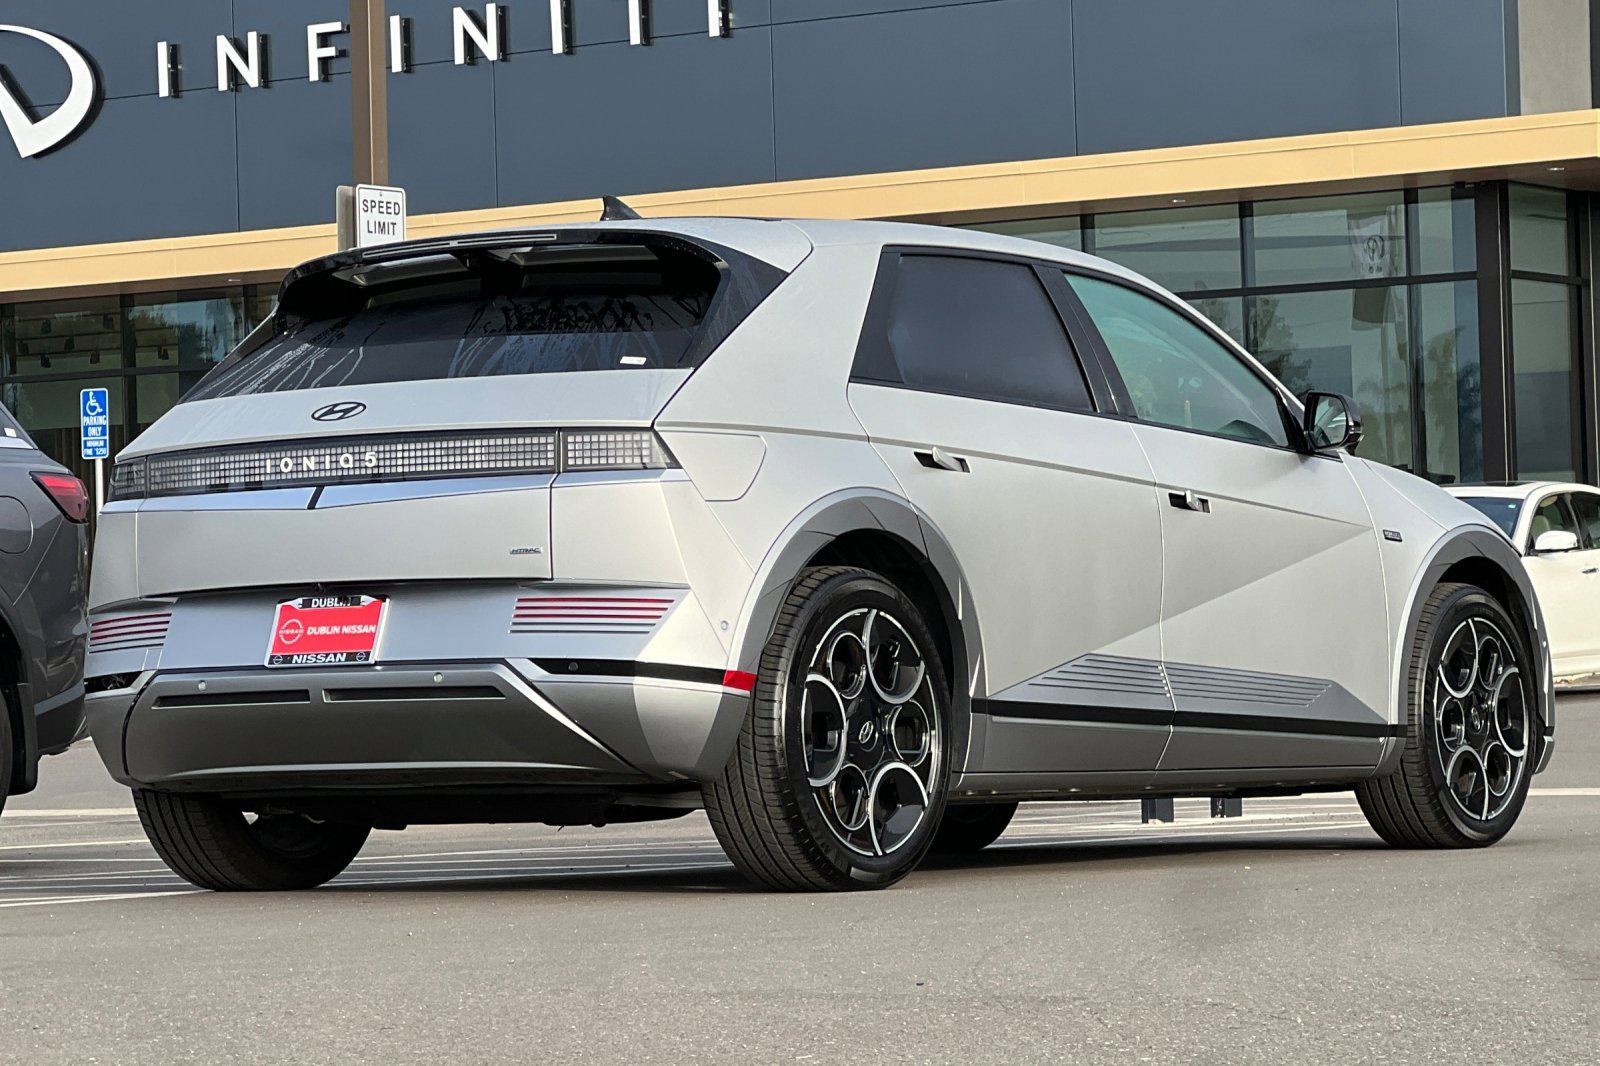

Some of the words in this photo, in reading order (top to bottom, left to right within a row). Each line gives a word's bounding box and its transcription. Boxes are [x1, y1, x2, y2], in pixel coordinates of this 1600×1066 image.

[362, 199, 401, 216] SPEED
[367, 220, 397, 236] LIMIT
[83, 415, 107, 426] PARKING
[87, 426, 102, 437] ONLY
[265, 453, 354, 474] IONIQ
[364, 451, 378, 468] 5
[311, 597, 351, 608] DUBL
[306, 626, 341, 636] DUBLIN
[341, 624, 377, 634] NISSAN
[291, 653, 347, 664] NISSAN
